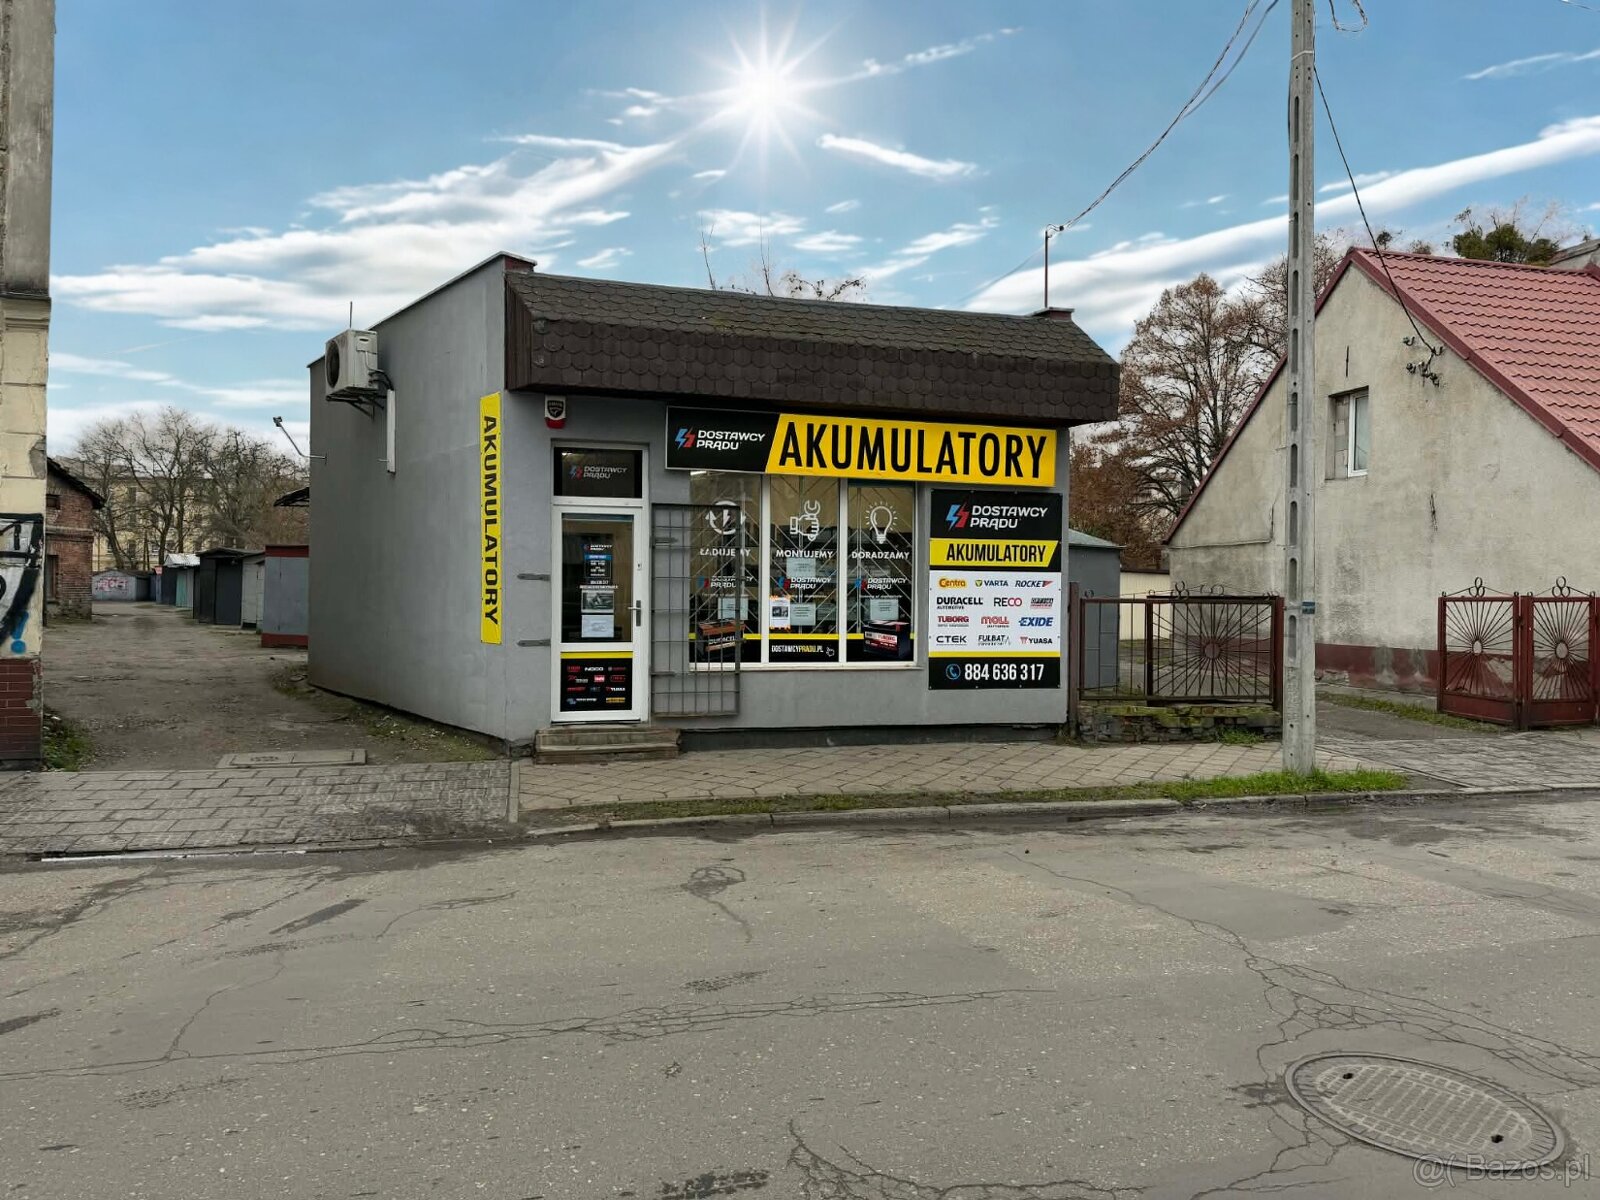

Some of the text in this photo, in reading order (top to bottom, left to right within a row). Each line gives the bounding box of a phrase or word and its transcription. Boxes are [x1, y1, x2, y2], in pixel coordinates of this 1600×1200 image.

[698, 429, 766, 442] DOSTAWCY
[696, 440, 739, 451] PRĄDU
[779, 421, 1047, 479] AKUMULATORY
[972, 505, 1048, 518] DOSTAWCY
[483, 415, 500, 625] AKUMULATORY
[970, 518, 1018, 531] PRĄDU
[776, 549, 833, 559] MONTUJEMY
[851, 550, 910, 560] DORADZAMY
[946, 543, 1046, 563] AKUMULATORY
[791, 576, 831, 584] DOSTAWCY
[868, 577, 907, 585] DOSTAWCY
[939, 578, 967, 588] Centra
[1015, 580, 1053, 588] ROCKET
[936, 597, 984, 605] DURACELL
[993, 597, 1023, 607] RECO
[1018, 617, 1054, 627] EXIDE
[936, 635, 967, 643] CTEK
[978, 634, 1005, 642] FULBAT
[964, 663, 1045, 681] 884 636 317
